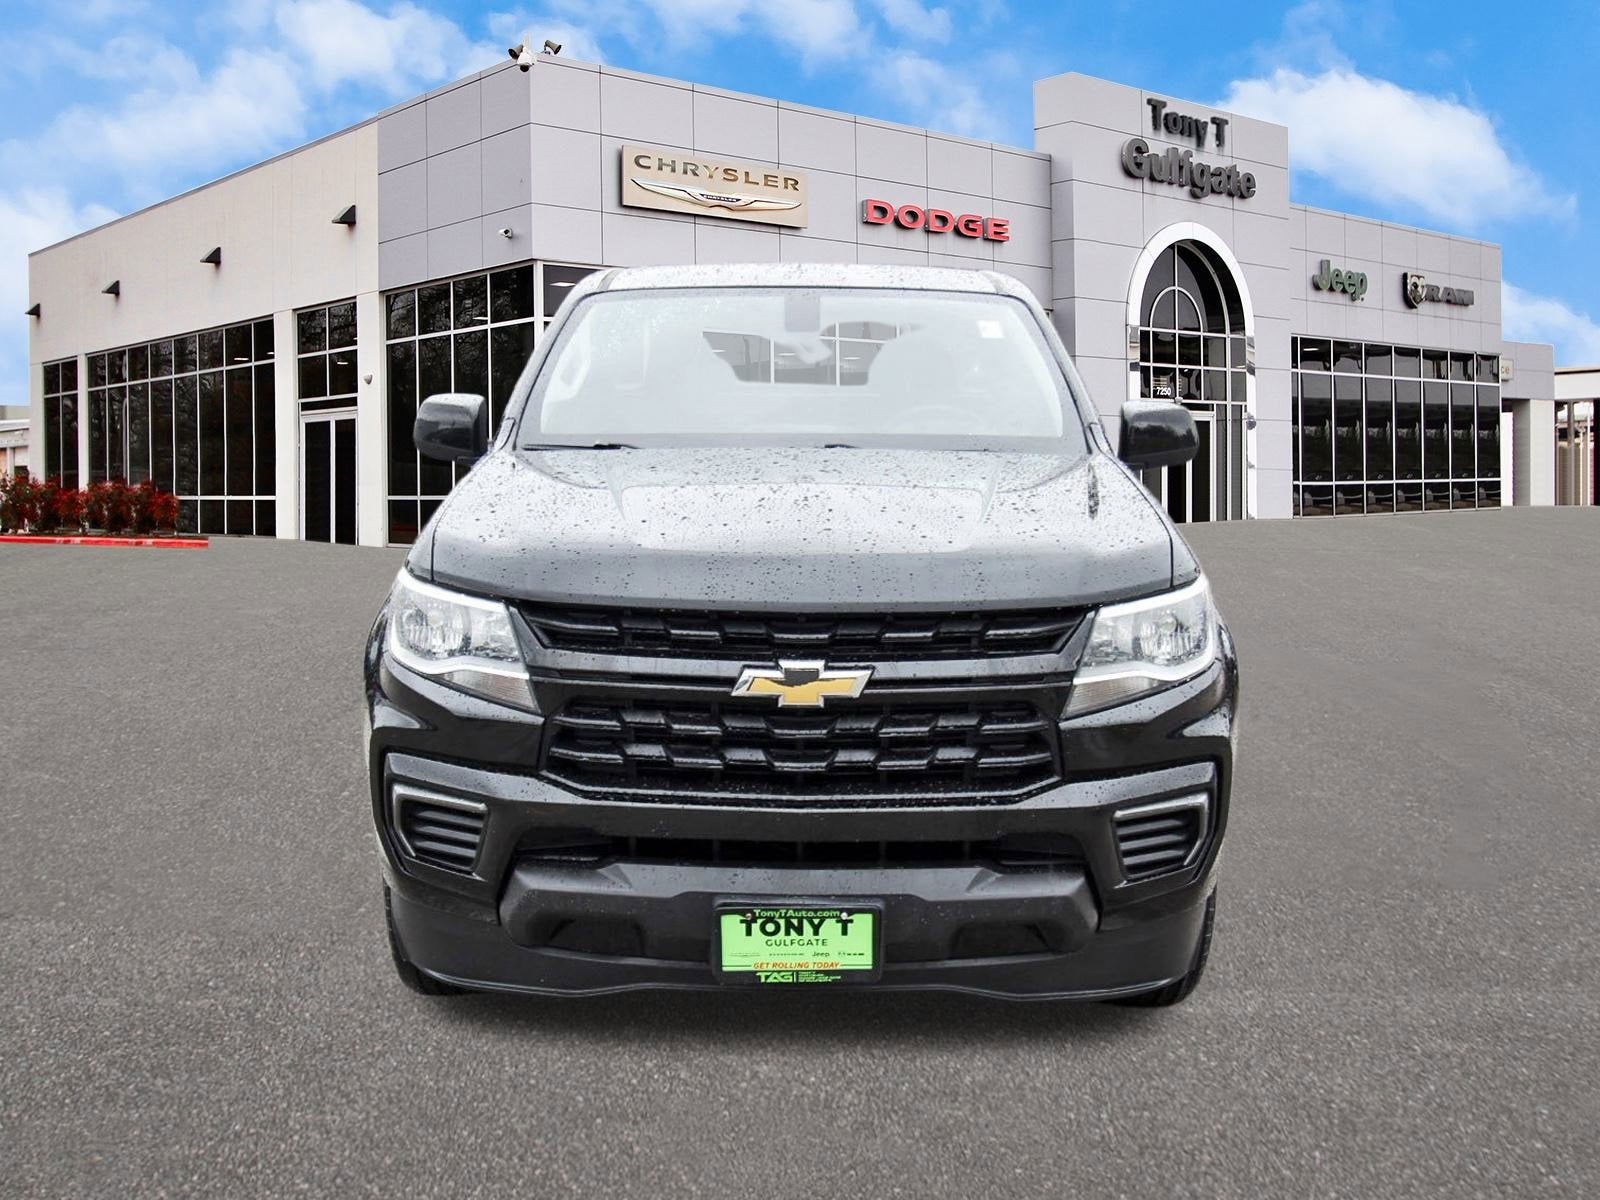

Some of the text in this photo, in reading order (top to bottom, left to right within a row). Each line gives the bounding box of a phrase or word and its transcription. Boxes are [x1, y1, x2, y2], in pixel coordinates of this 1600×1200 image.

[1147, 98, 1229, 148] Tony T
[633, 154, 800, 192] CHRYSLER
[1121, 137, 1257, 199] Gulfgate
[862, 198, 1010, 242] DODGE
[1312, 259, 1368, 301] Jeep
[1425, 284, 1475, 306] RAM
[1156, 386, 1172, 396] 7250
[753, 909, 840, 918] TonyTAuto.com
[740, 918, 854, 937] TONY T
[765, 938, 828, 947] GULFGATE
[753, 961, 840, 970] GET ROLLING TODAY
[756, 971, 794, 983] TAG
